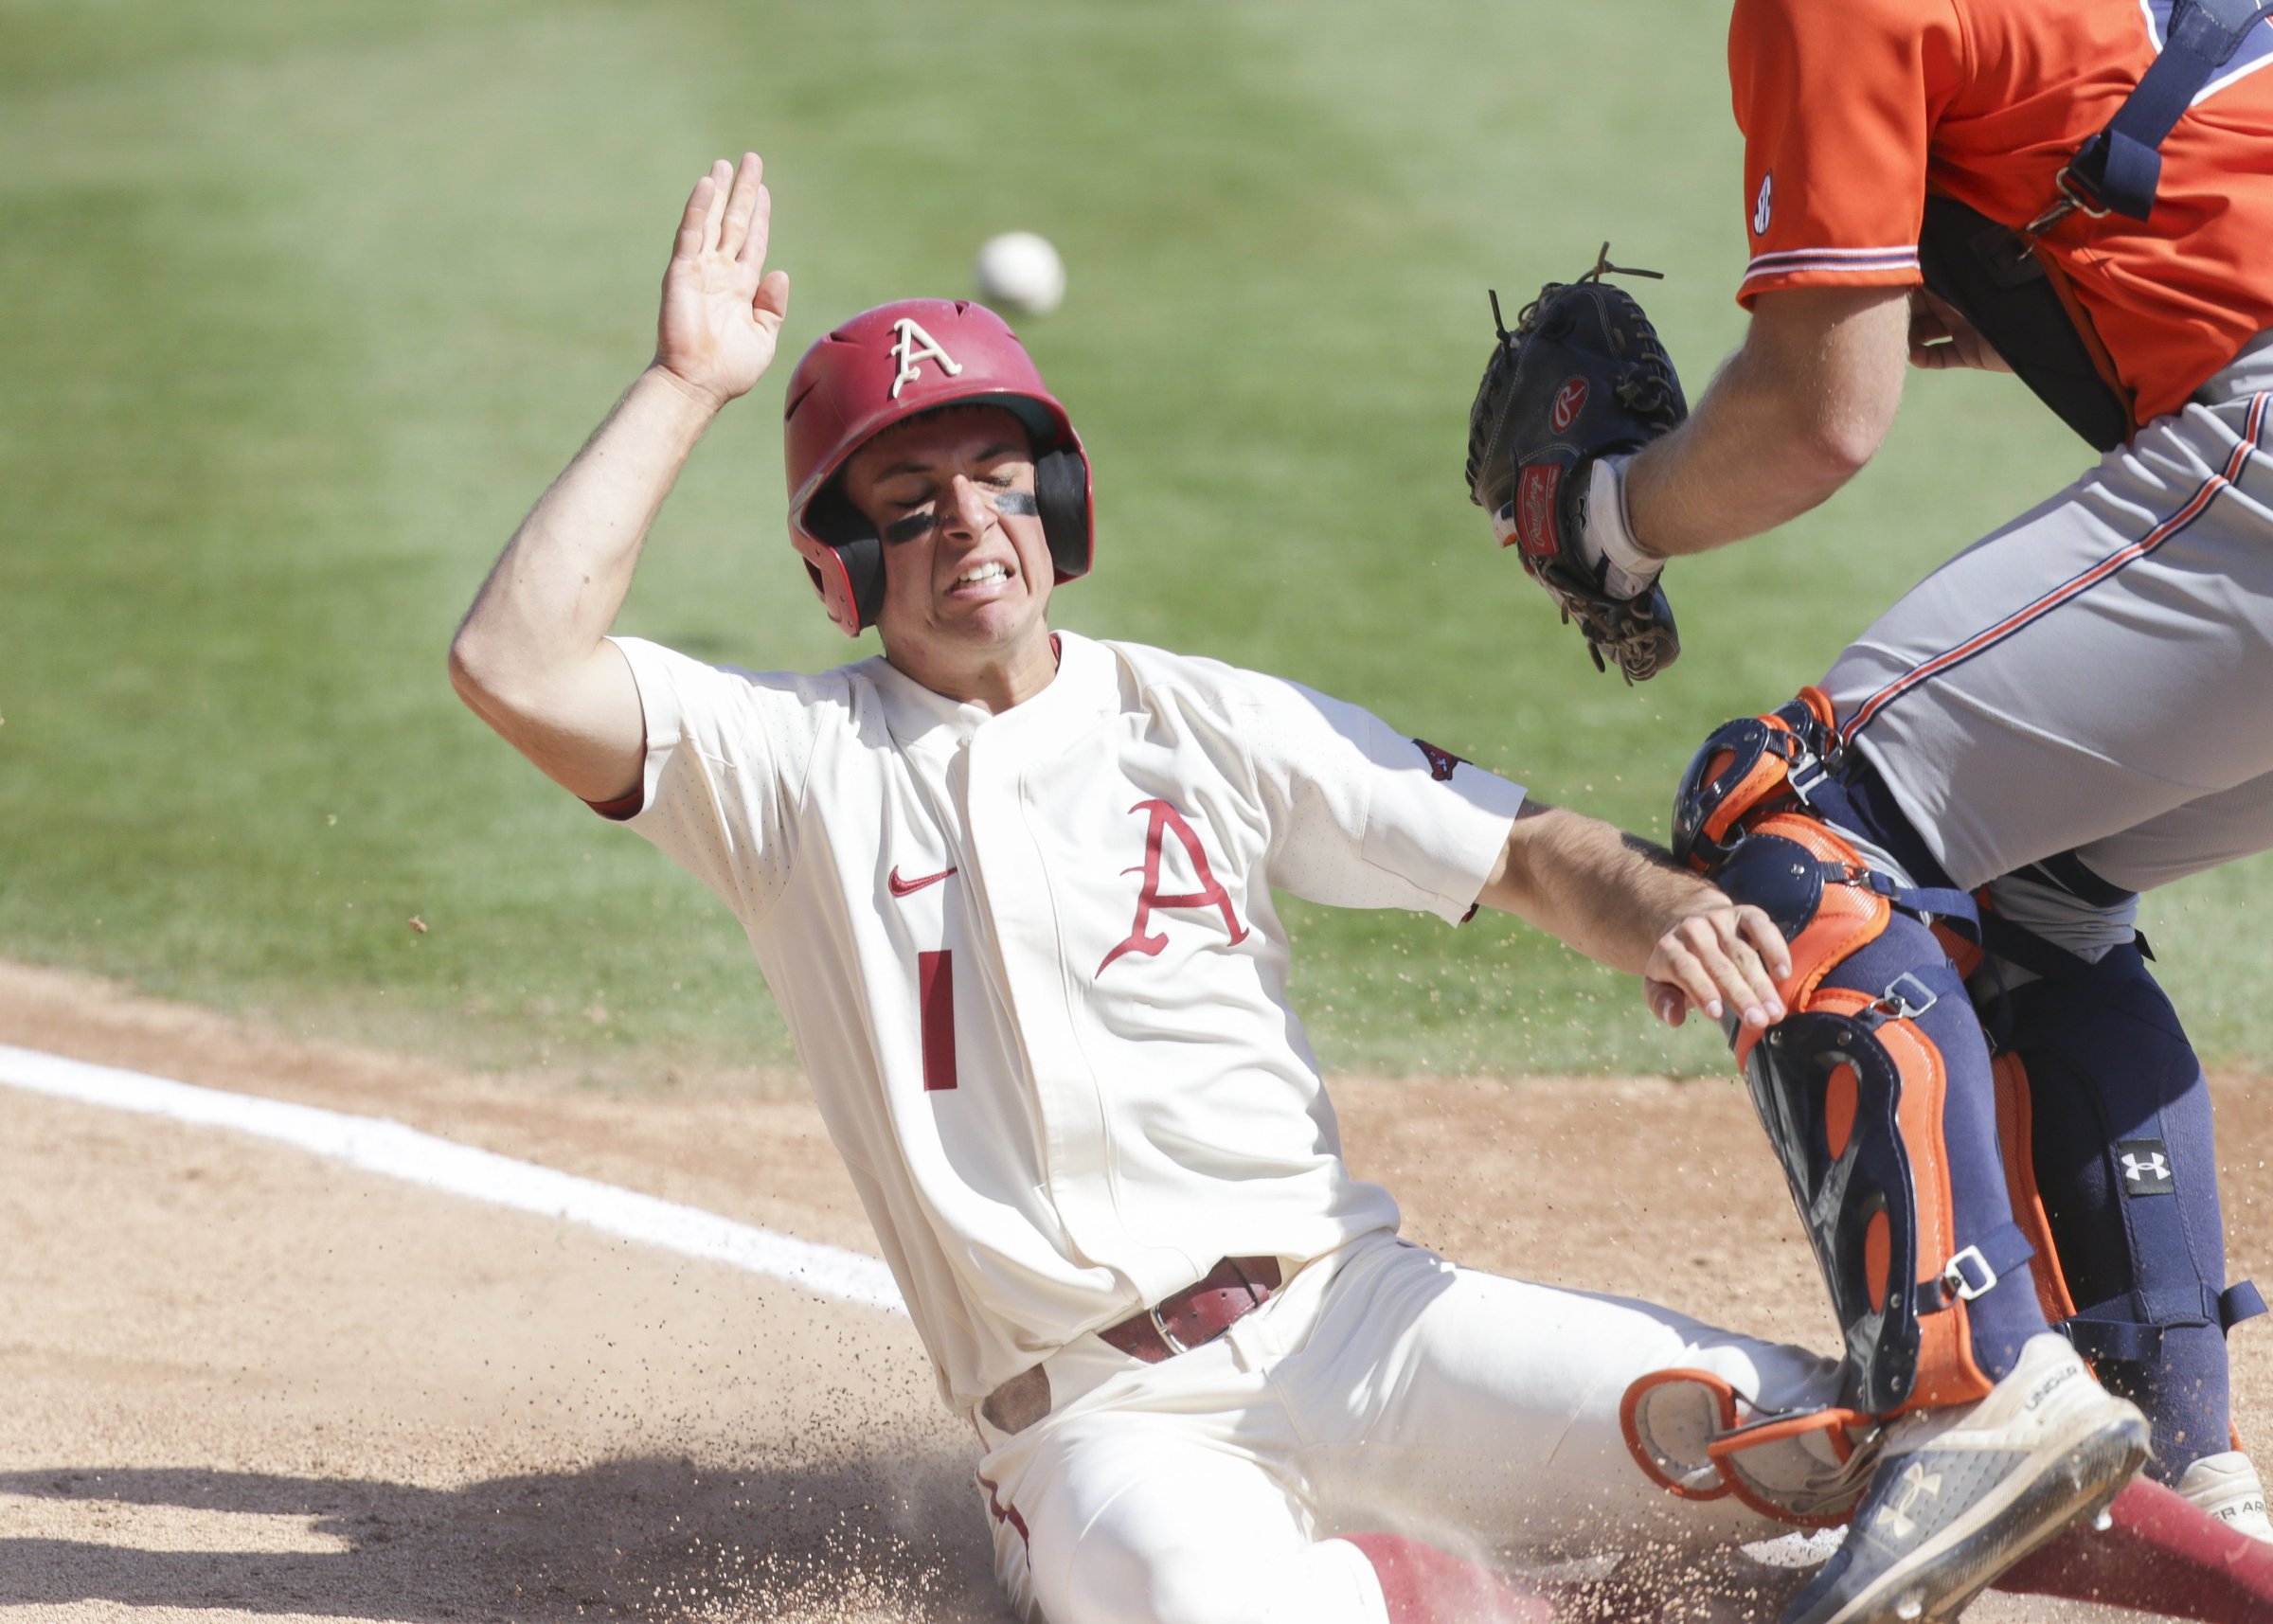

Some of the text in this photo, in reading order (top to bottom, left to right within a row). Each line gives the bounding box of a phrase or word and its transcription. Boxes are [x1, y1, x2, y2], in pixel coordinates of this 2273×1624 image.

[890, 317, 963, 399] A
[1555, 385, 1585, 428] R
[1525, 473, 1548, 548] Rawlings
[1095, 798, 1250, 980] A
